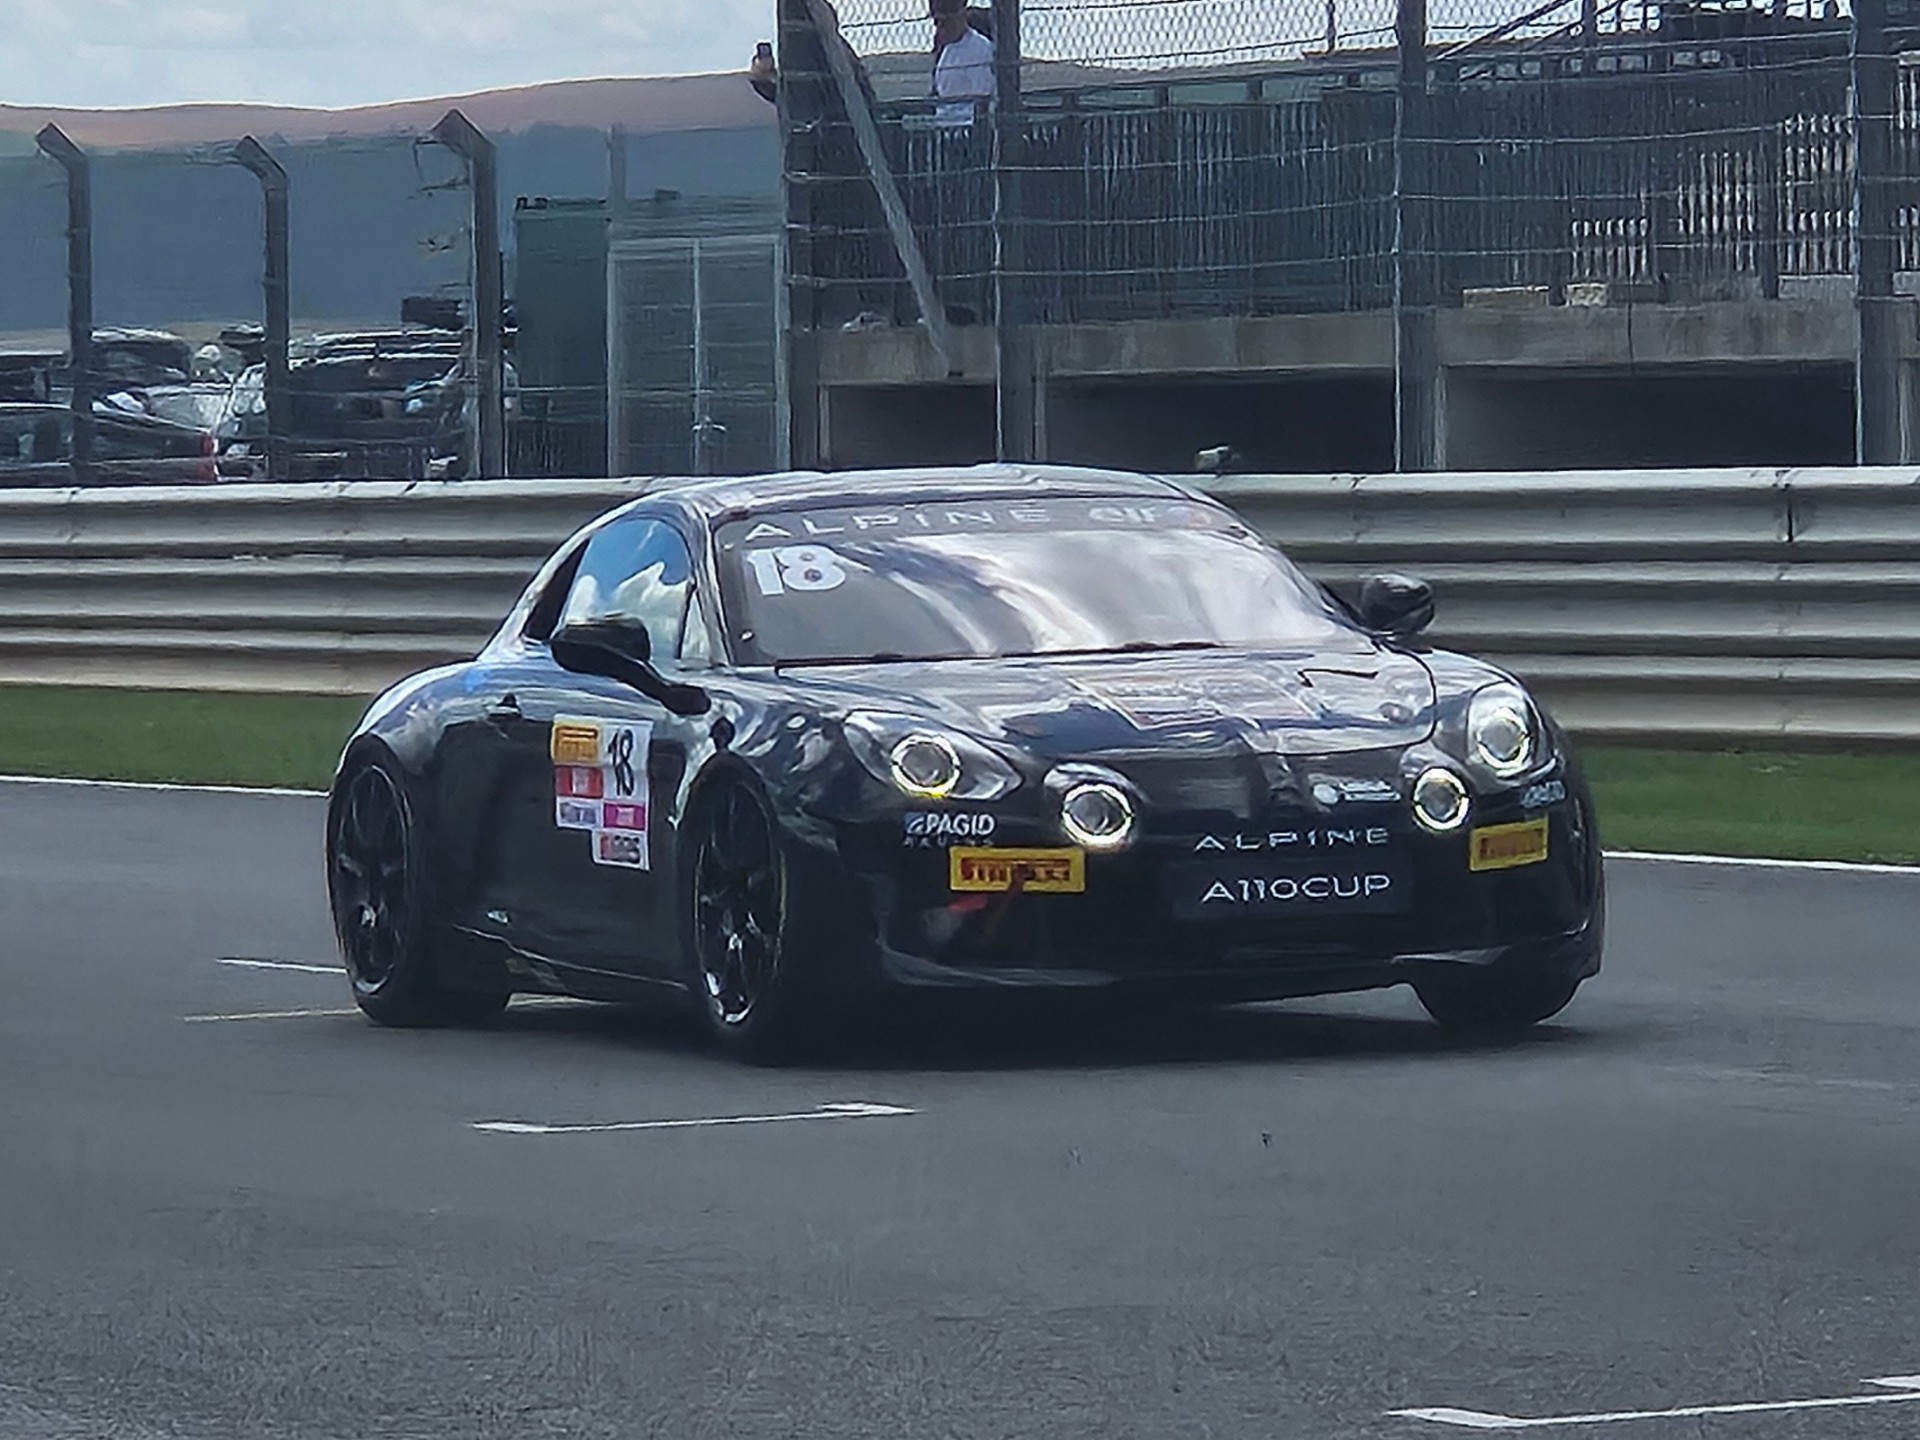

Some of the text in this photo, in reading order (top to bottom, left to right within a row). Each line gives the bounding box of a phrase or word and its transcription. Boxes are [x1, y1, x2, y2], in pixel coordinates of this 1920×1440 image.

[745, 508, 1051, 542] ALPINE
[747, 544, 847, 596] 18
[607, 728, 635, 797] 18
[924, 812, 996, 836] PAGID
[1194, 827, 1389, 851] ALPINE
